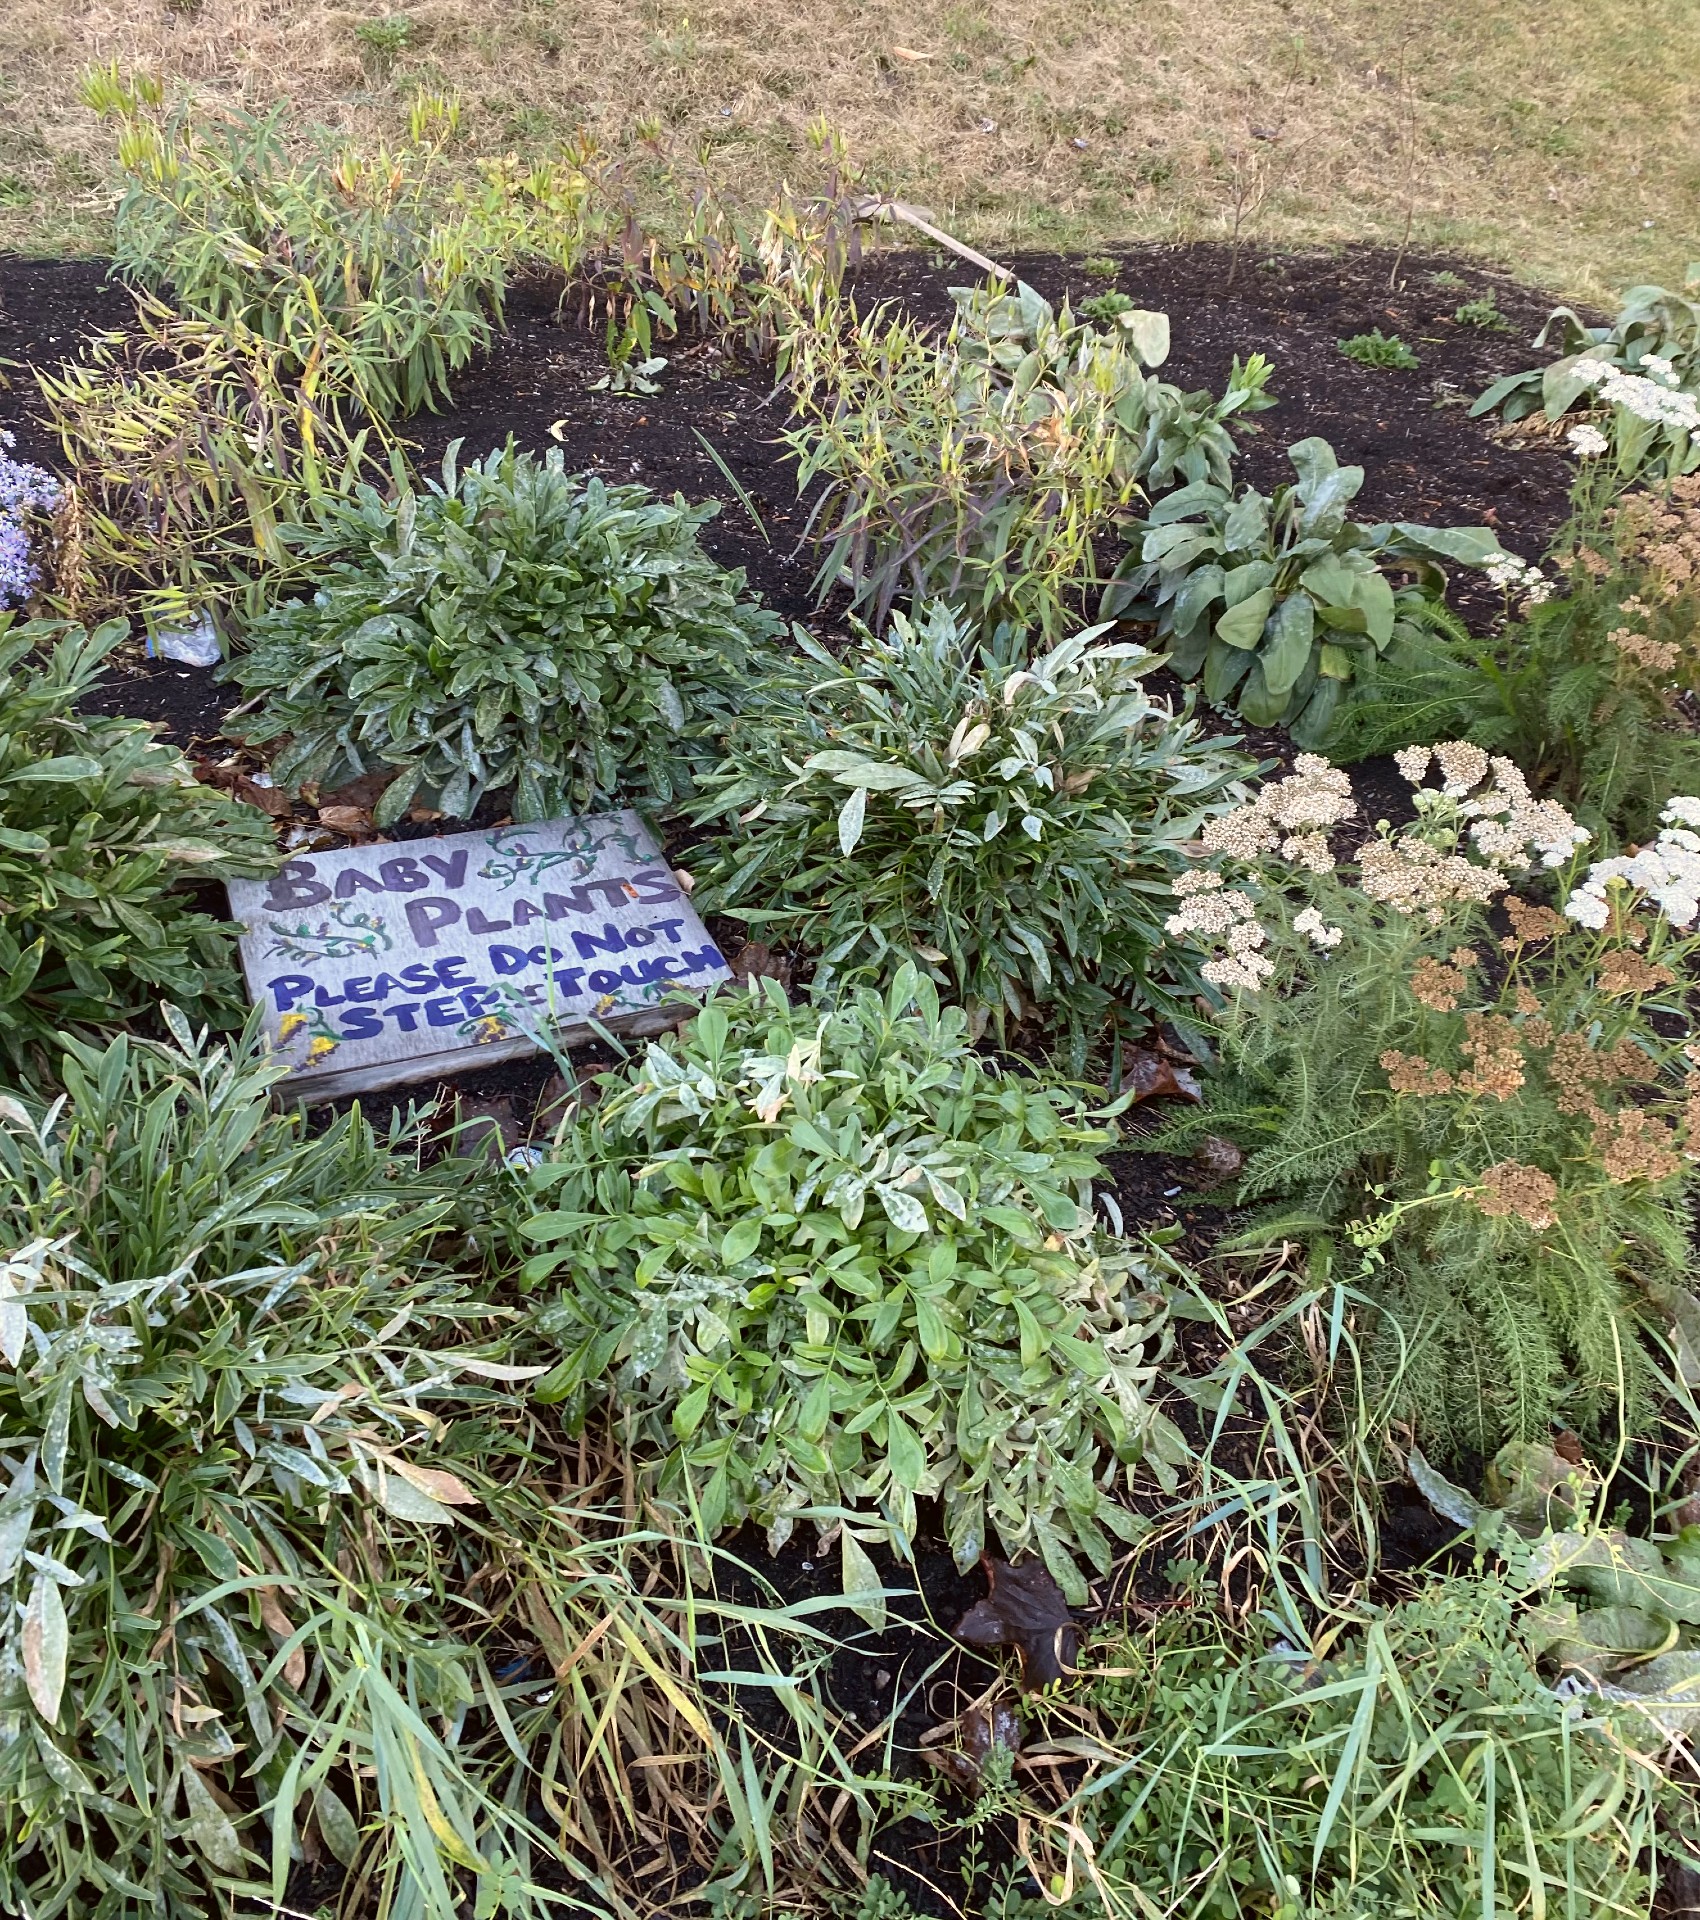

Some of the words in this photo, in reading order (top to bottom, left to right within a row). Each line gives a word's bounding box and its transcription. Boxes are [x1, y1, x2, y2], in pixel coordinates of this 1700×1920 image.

[262, 849, 469, 912] BABY
[404, 869, 681, 948] PLANTS
[267, 956, 476, 1012] PLEASE
[488, 944, 563, 975] DO
[571, 918, 685, 960] NOT
[338, 985, 500, 1040] STEP
[543, 944, 726, 998] TOUCH
